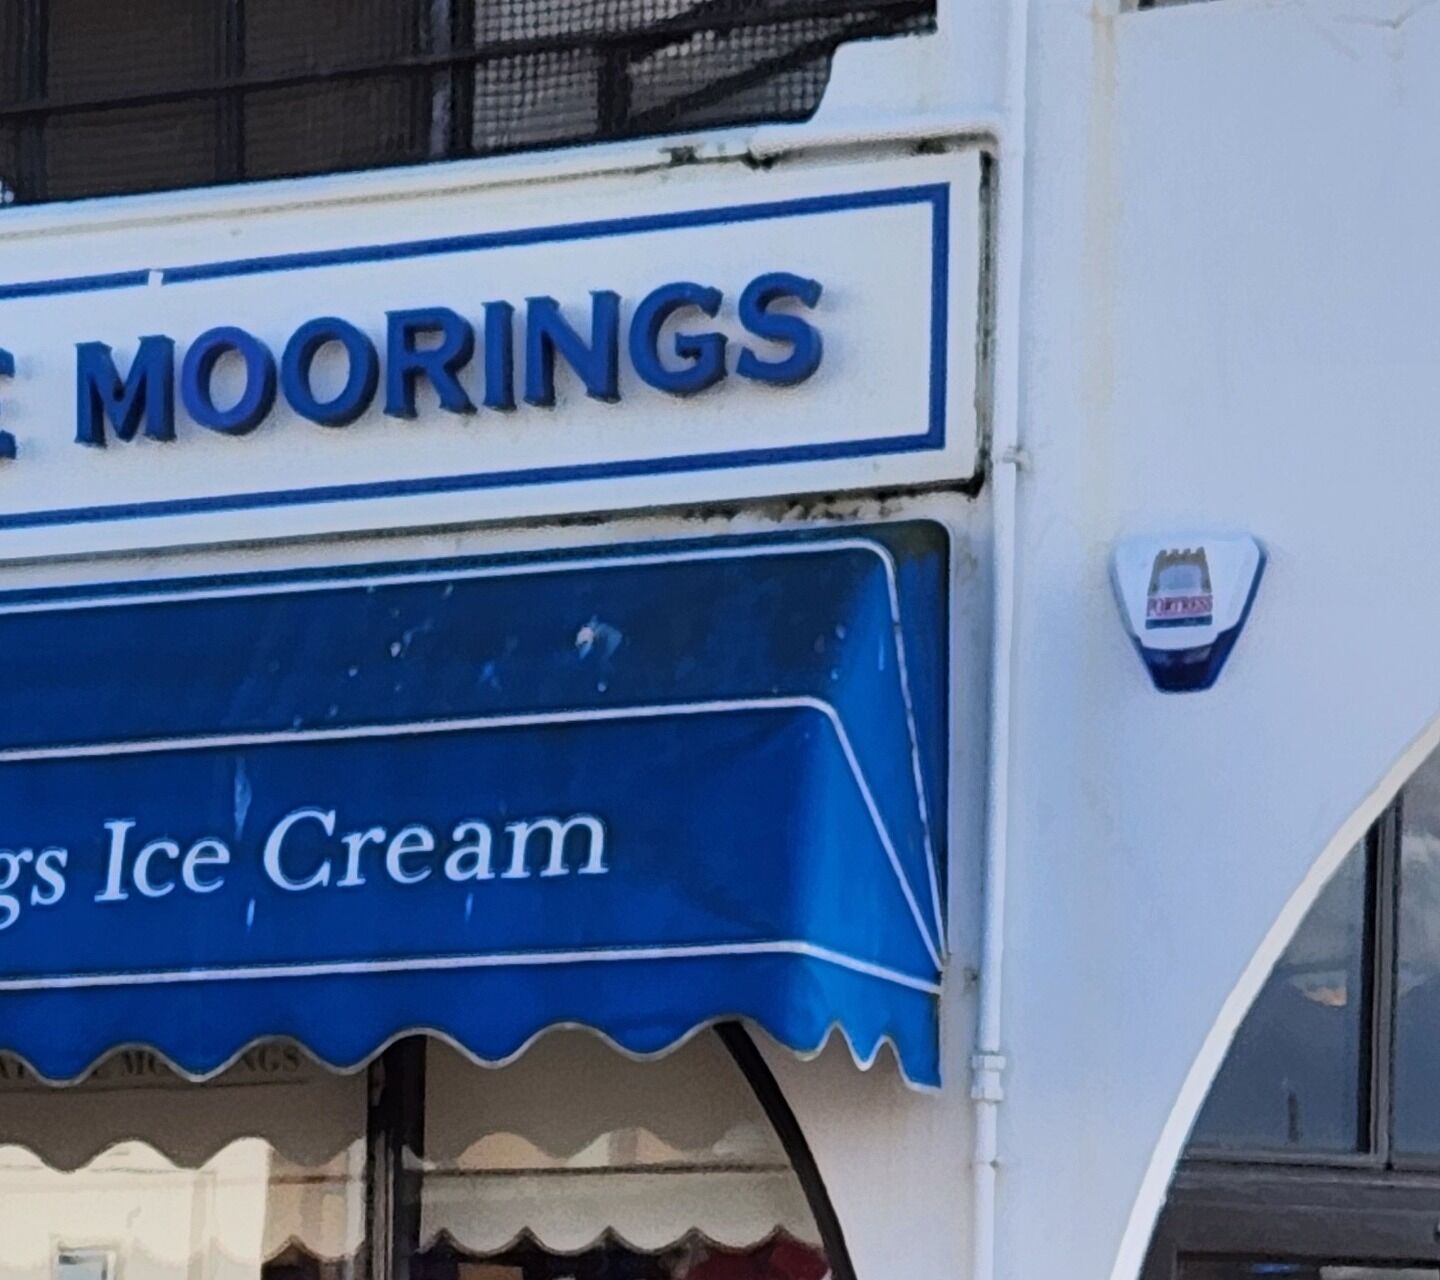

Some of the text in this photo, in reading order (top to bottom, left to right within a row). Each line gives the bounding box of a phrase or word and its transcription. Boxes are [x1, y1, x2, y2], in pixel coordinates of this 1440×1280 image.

[74, 270, 824, 450] MOORINGS
[95, 817, 231, 904] Ice
[262, 807, 609, 892] Cream
